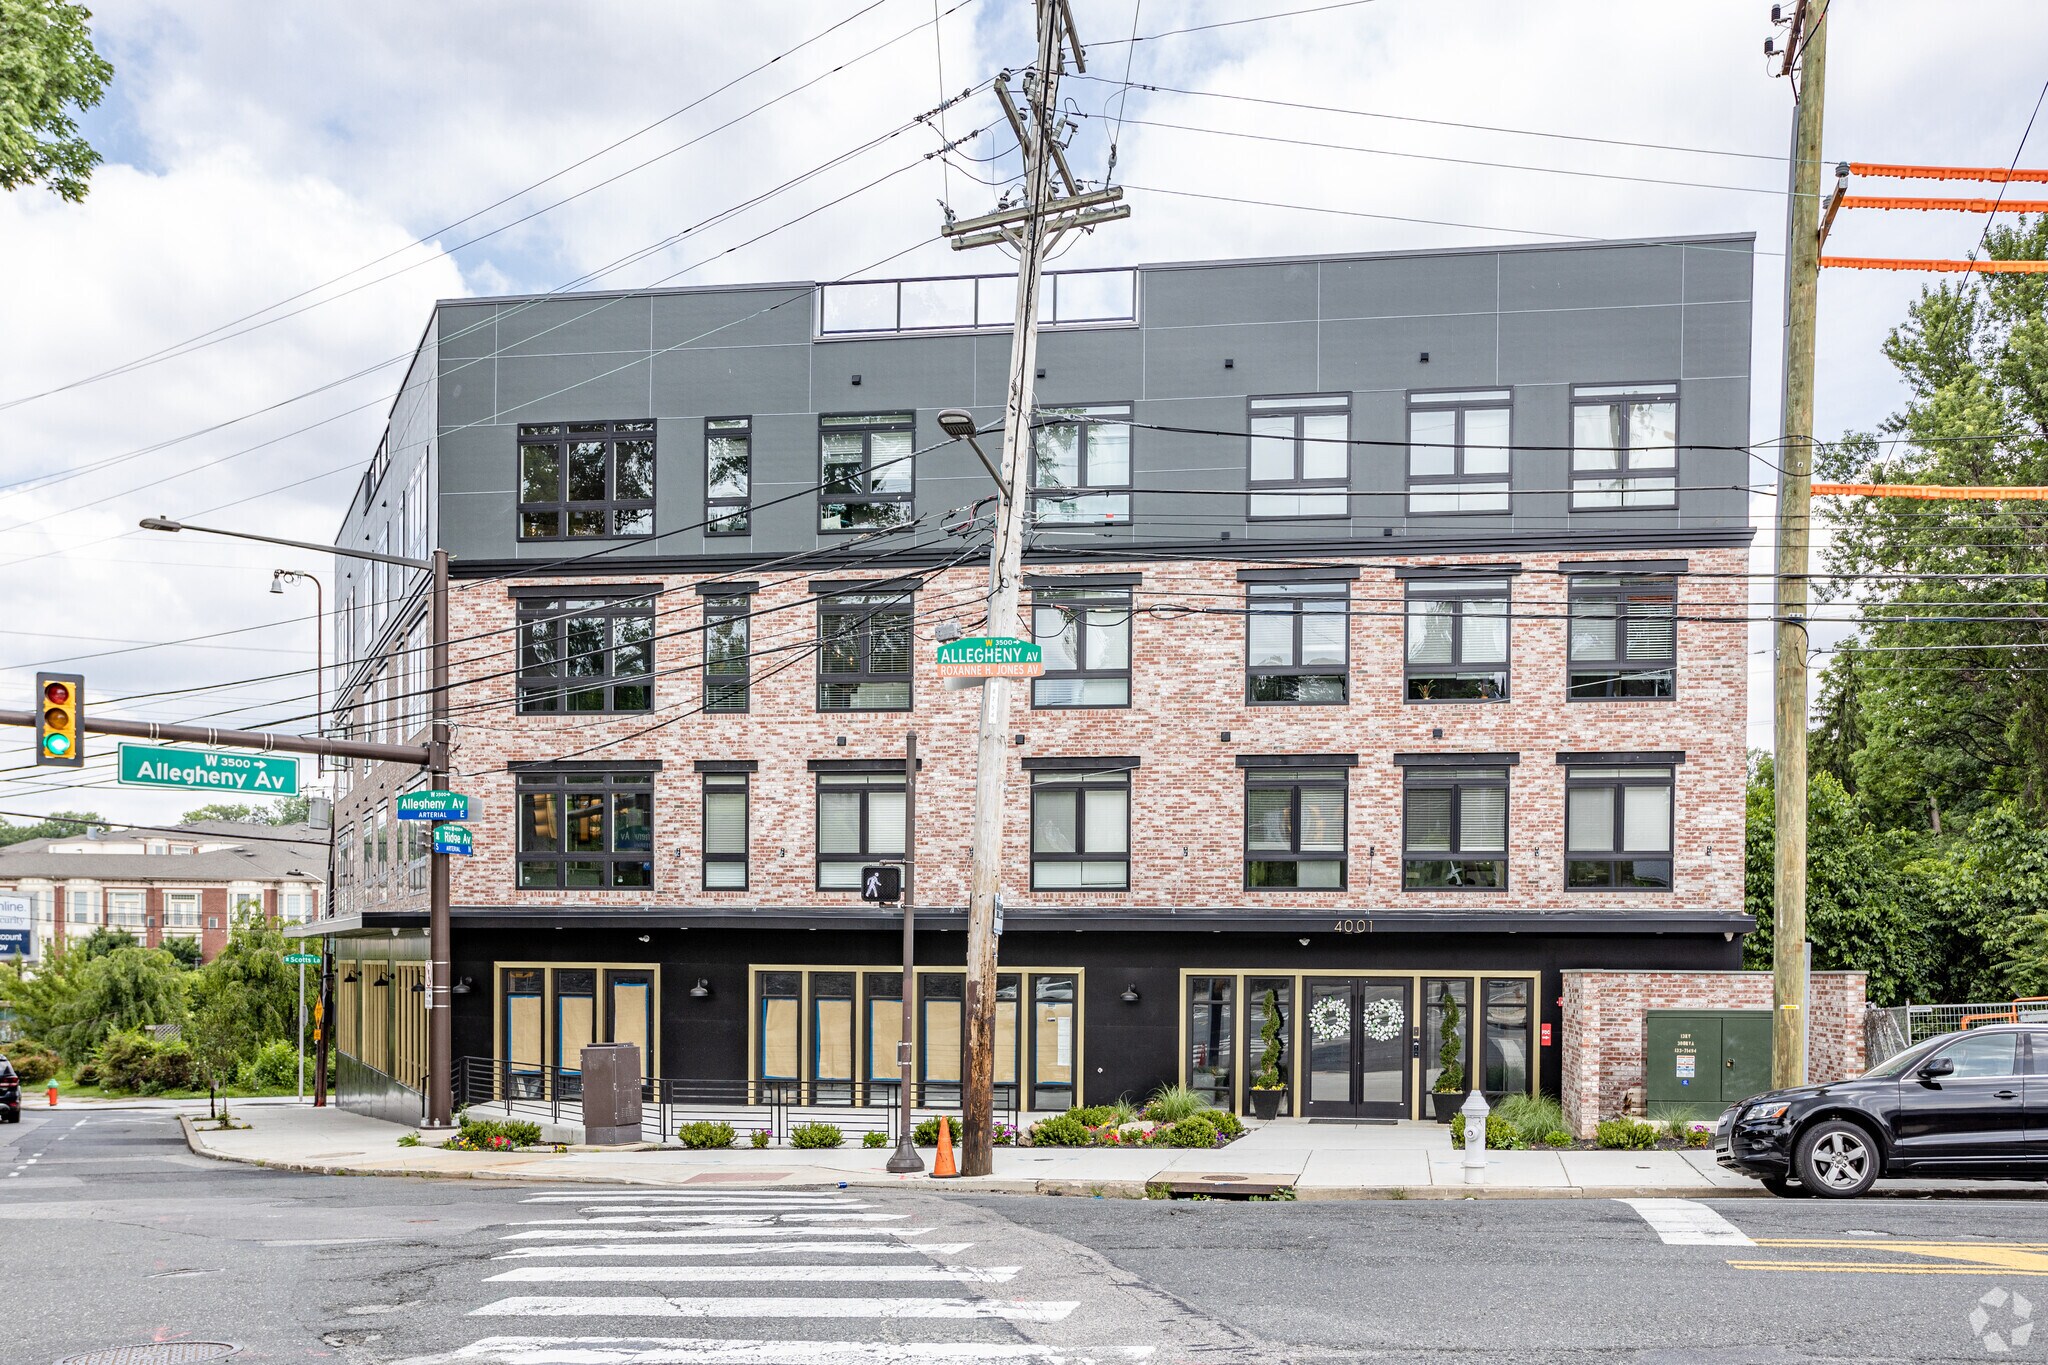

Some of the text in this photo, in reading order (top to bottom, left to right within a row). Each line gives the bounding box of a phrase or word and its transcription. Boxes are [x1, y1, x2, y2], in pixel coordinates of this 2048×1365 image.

[985, 639, 993, 647] W
[940, 647, 1038, 663] ALLEGHENY AV
[940, 664, 1039, 676] ROXANNE H. JONES AV
[204, 754, 251, 769] W 3500
[136, 760, 285, 790] Allegheny Av
[401, 797, 465, 810] Allegheny Av
[460, 810, 465, 818] E
[444, 831, 471, 844] Ridge Av
[1334, 919, 1373, 933] 4001
